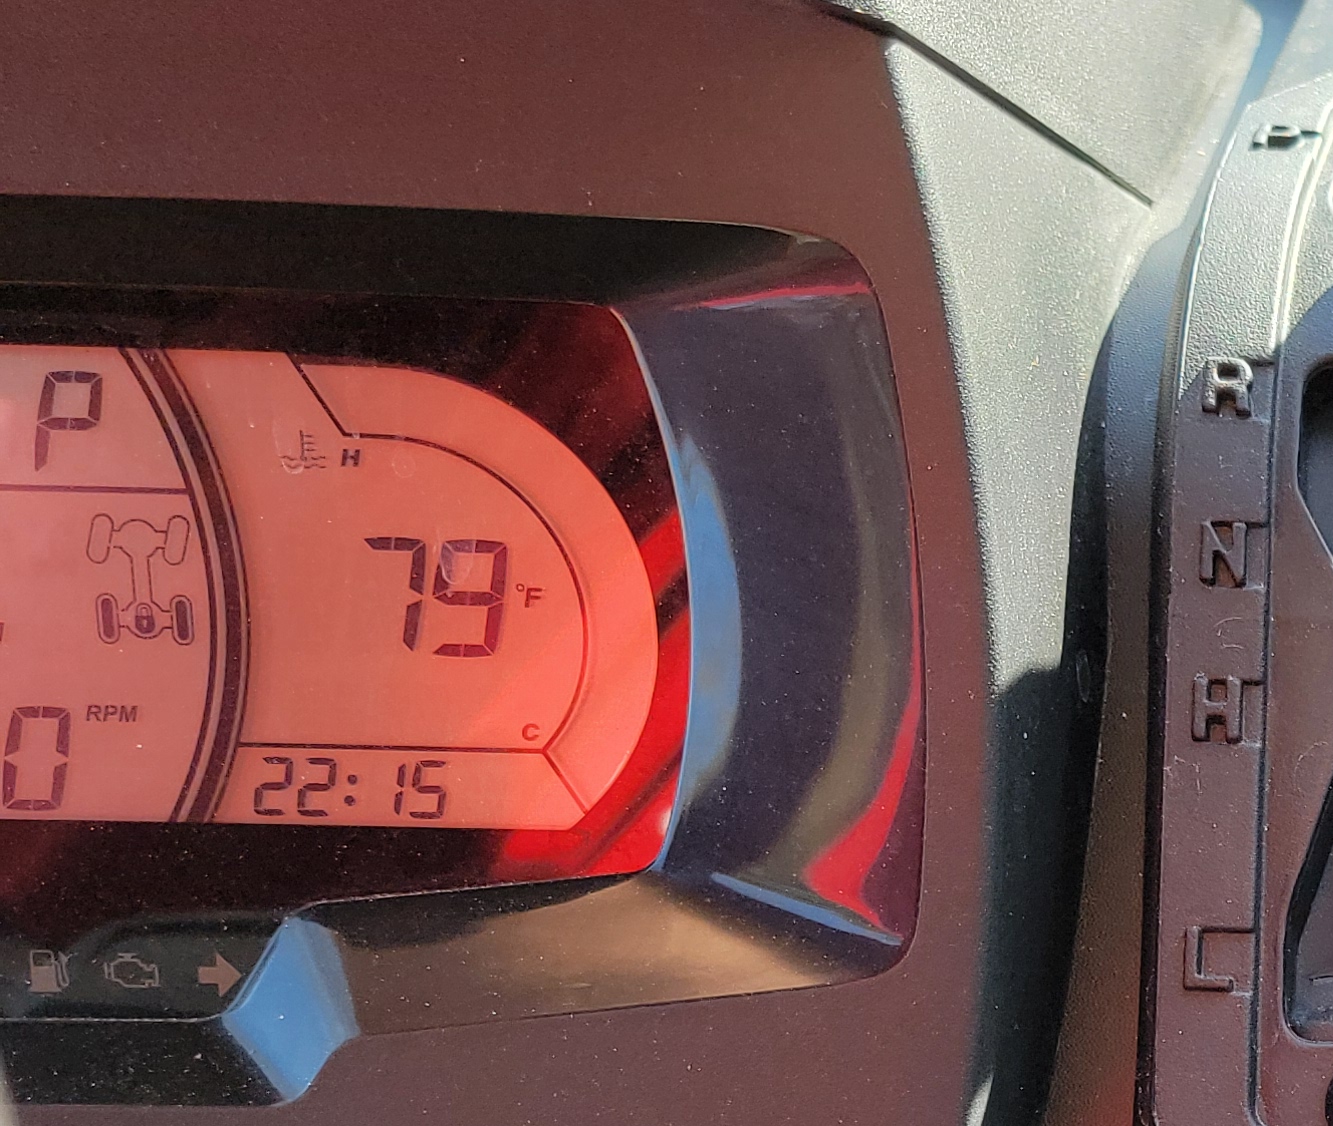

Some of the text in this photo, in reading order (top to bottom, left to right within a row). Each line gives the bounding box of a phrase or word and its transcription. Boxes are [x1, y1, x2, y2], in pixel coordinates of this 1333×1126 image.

[1202, 356, 1255, 418] R
[34, 370, 103, 472] P
[340, 448, 362, 468] H
[1200, 520, 1249, 589] N
[363, 536, 509, 659] 79
[85, 704, 139, 724] RPM
[521, 725, 541, 742] C
[1191, 674, 1244, 743] H
[253, 756, 448, 821] 22:15
[1183, 926, 1235, 992] L
